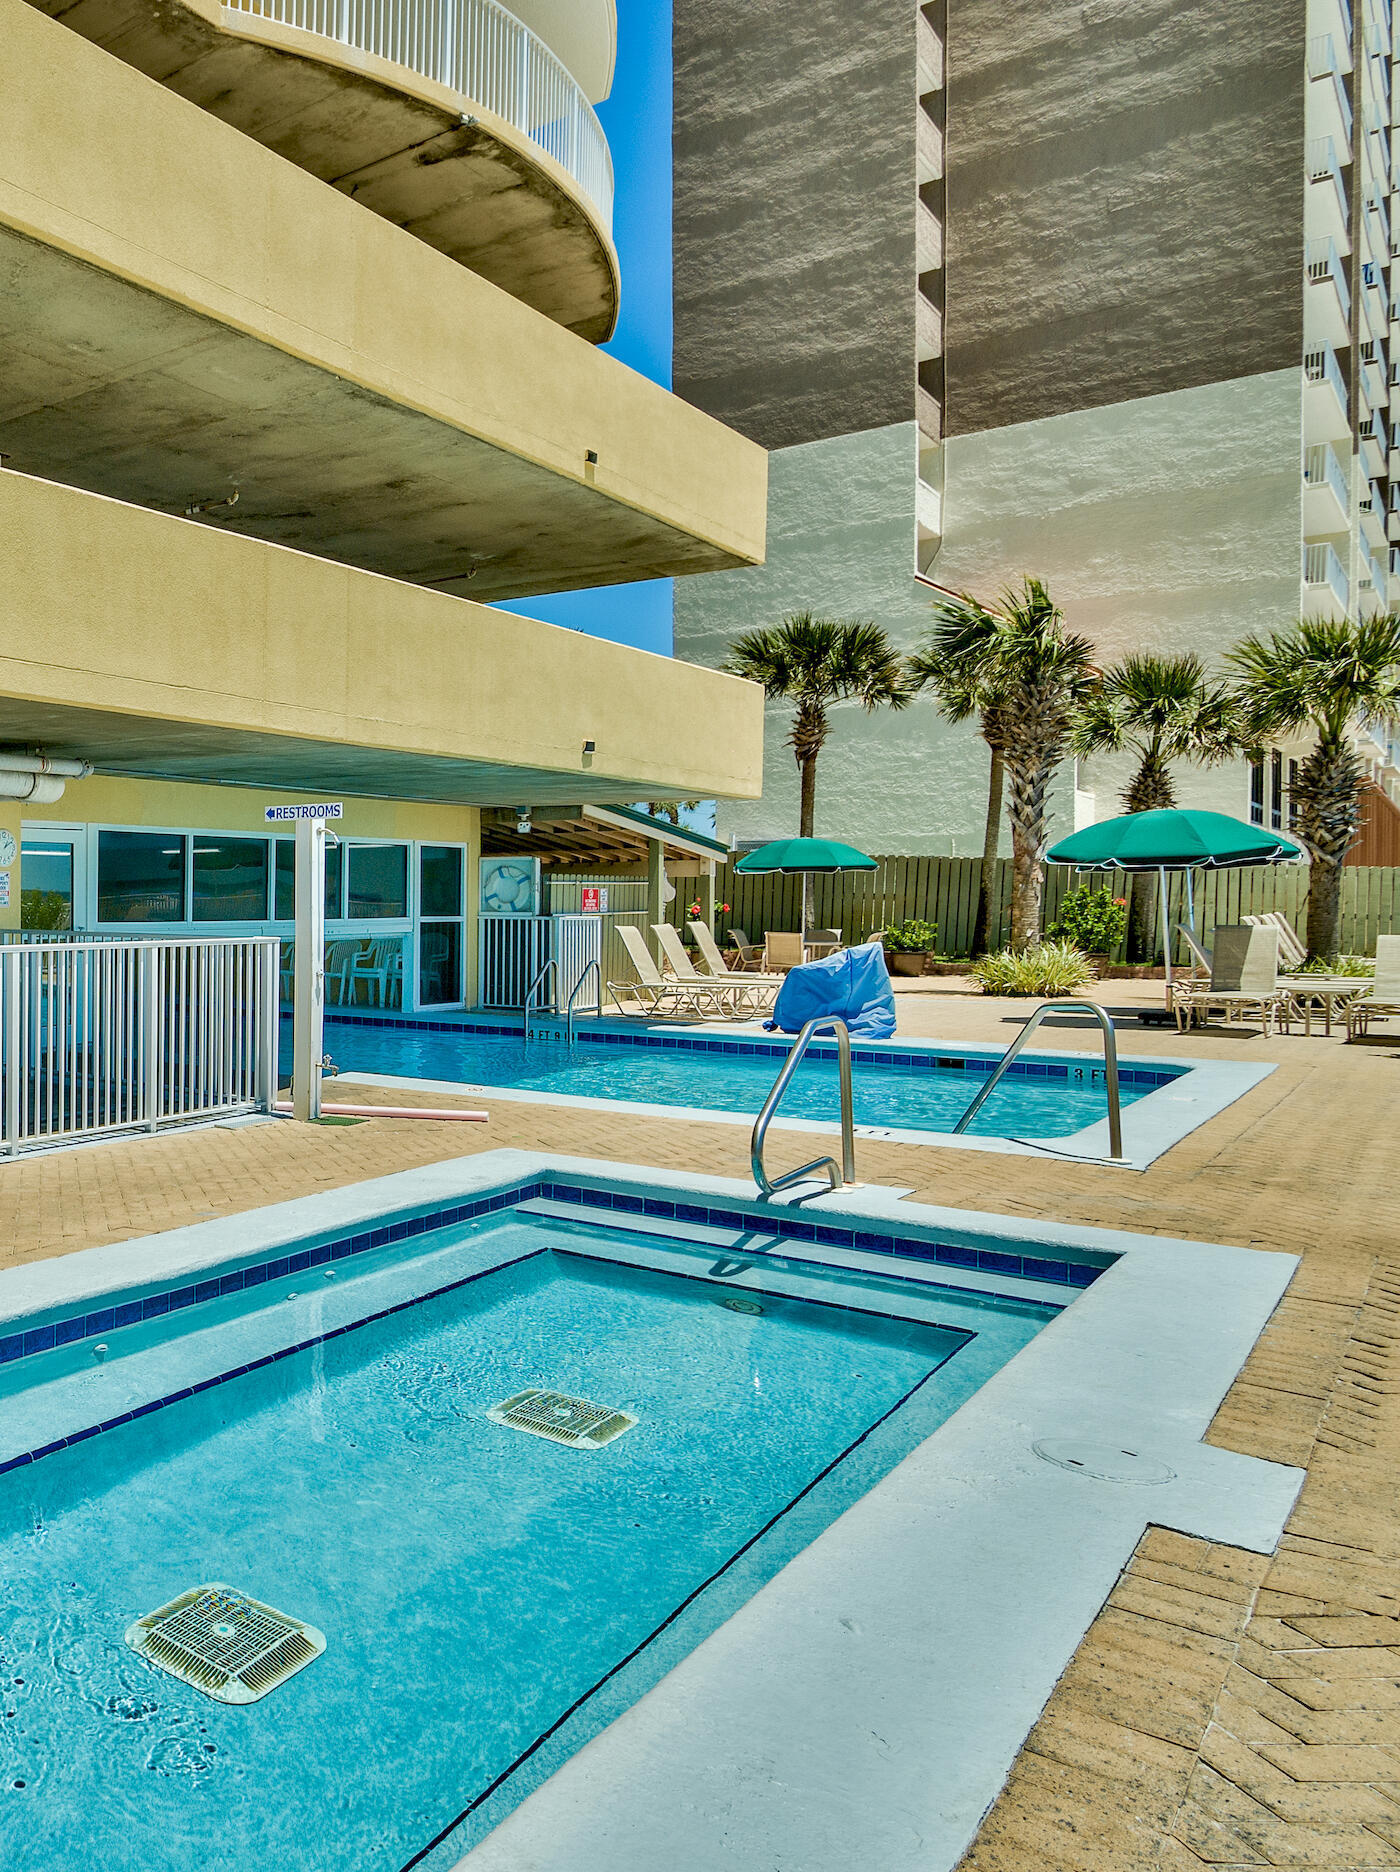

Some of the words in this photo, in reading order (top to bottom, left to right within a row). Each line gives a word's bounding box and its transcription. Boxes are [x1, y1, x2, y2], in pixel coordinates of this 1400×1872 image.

[276, 804, 340, 819] RESTROOMS
[528, 1029, 534, 1039] 4
[539, 1030, 551, 1040] FT
[1074, 1068, 1083, 1079] 3
